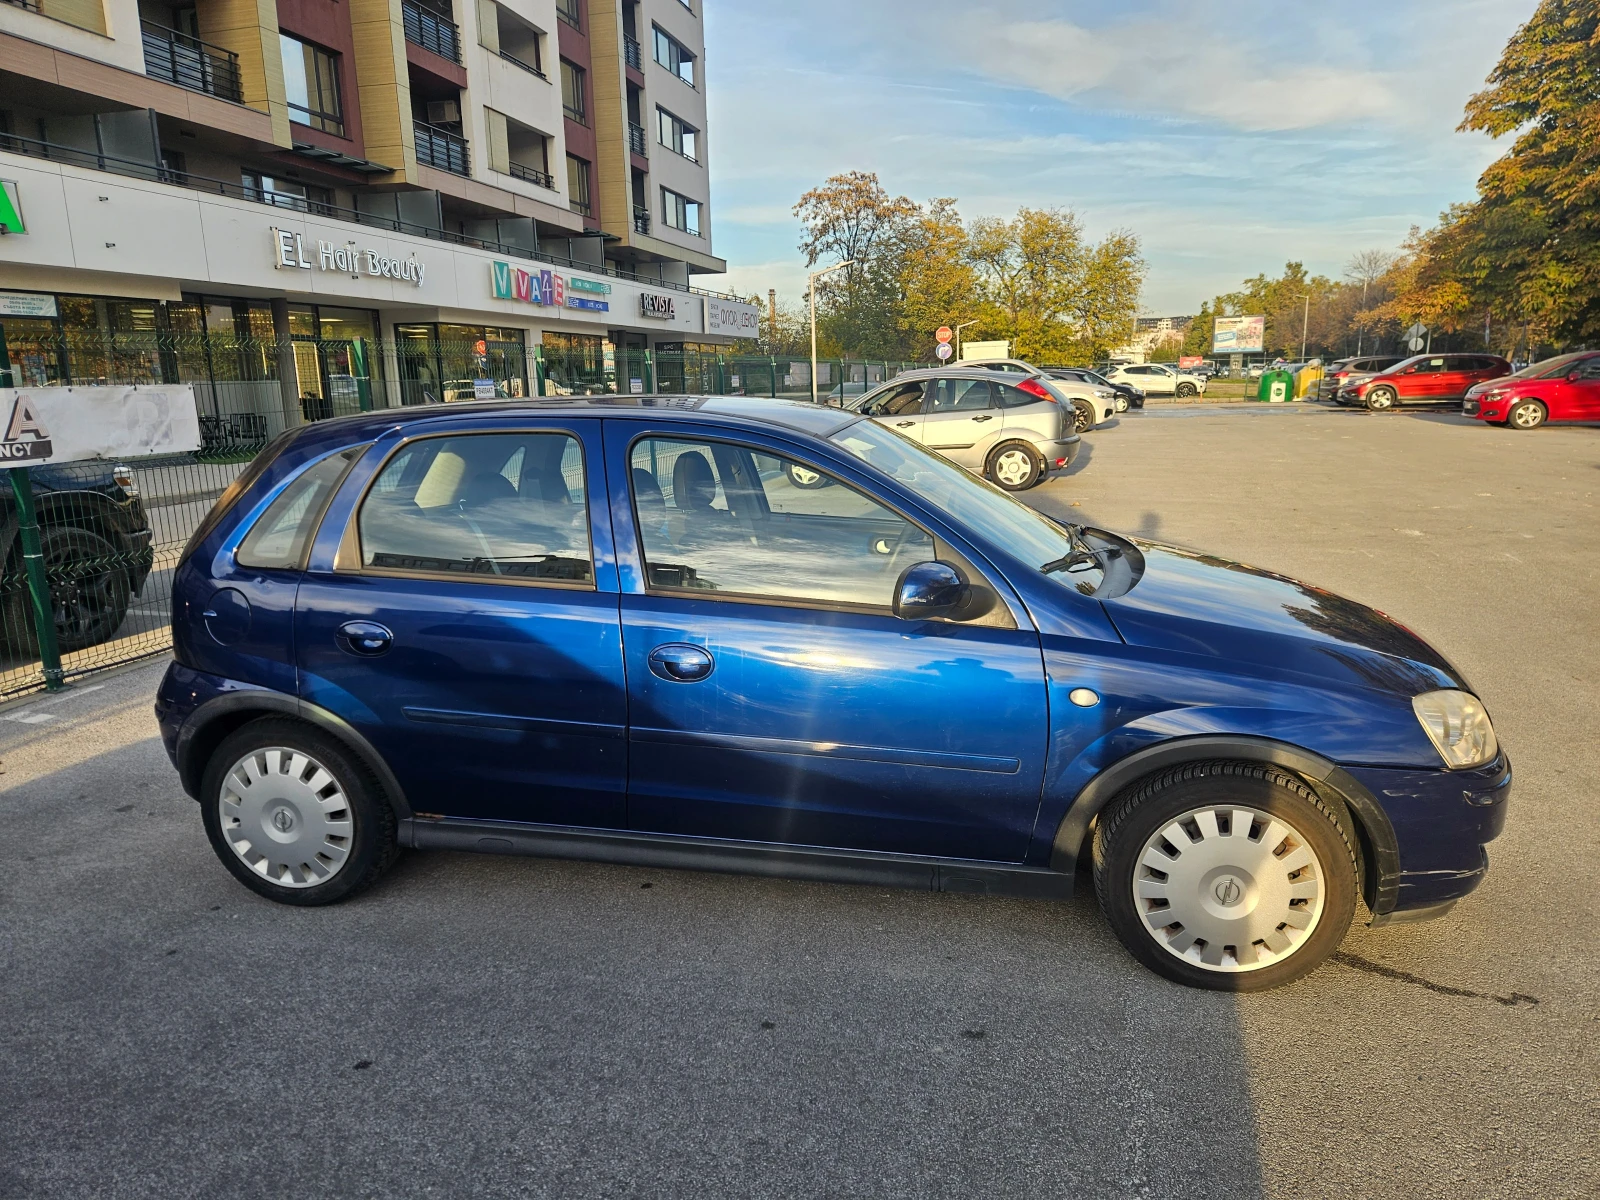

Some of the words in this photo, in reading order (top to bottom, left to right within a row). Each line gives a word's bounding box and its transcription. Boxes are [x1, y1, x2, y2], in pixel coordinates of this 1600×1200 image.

[277, 229, 311, 270] EL
[318, 239, 359, 273] Hair
[366, 249, 425, 288] Beauty
[643, 293, 675, 315] REVISTA
[937, 331, 951, 339] STOP
